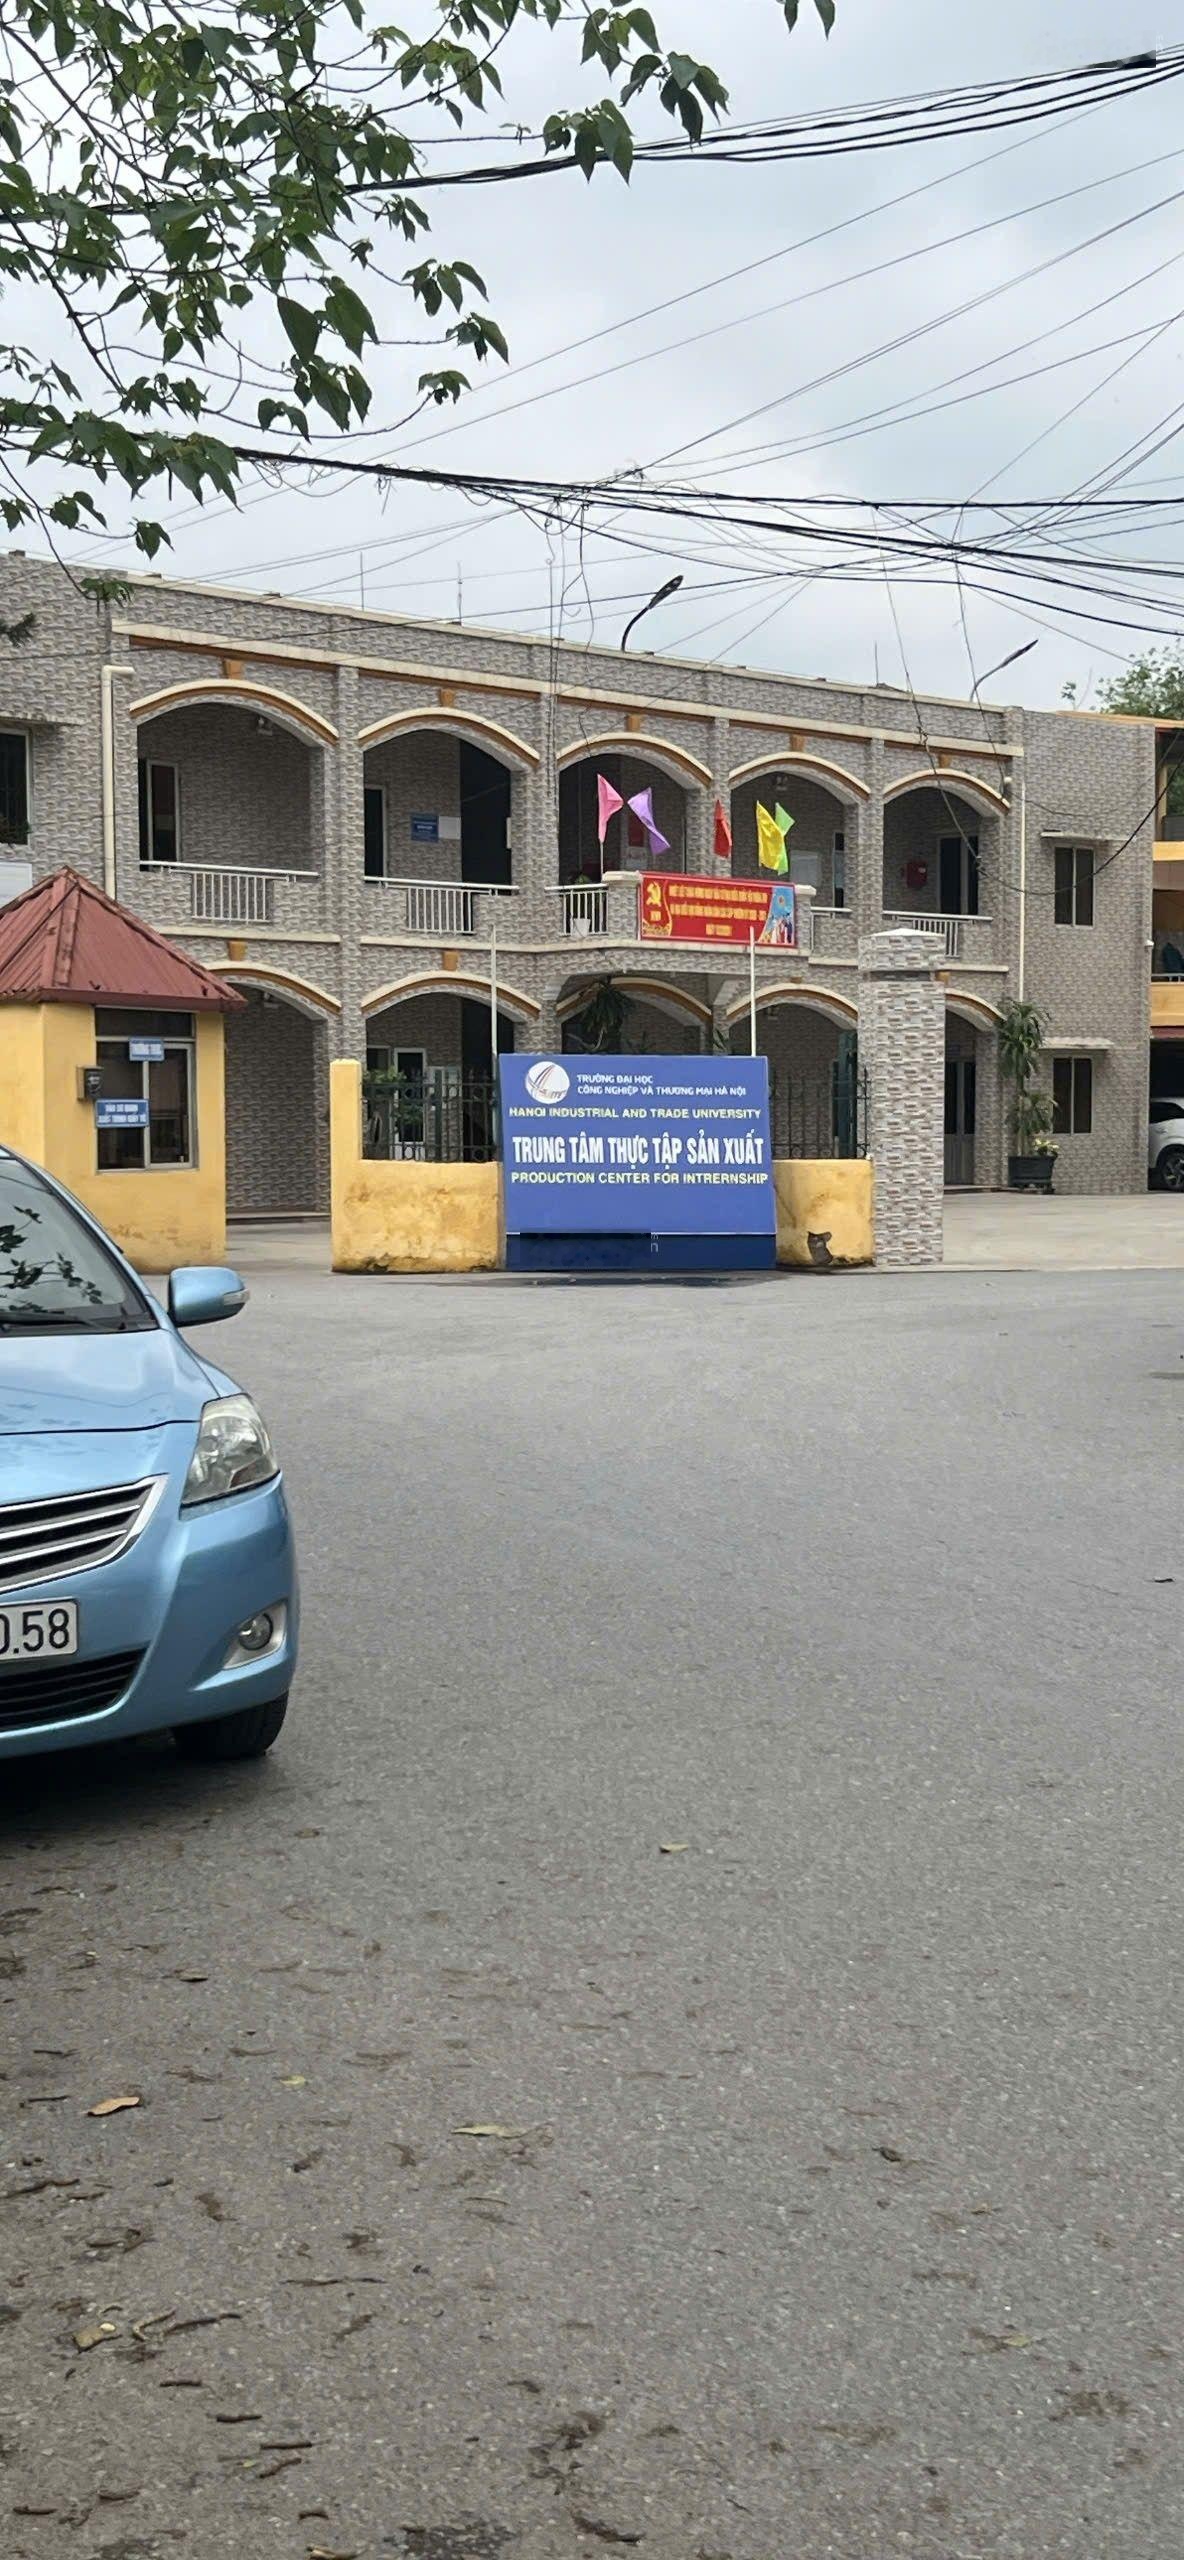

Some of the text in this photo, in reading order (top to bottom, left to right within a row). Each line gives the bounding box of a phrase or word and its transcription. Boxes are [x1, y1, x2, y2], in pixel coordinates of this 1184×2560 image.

[634, 1075, 653, 1087] HỌC
[577, 1084, 603, 1095] CÔNG
[604, 1086, 639, 1097] NGHIỆP
[639, 1086, 654, 1096] VÀ
[714, 1085, 729, 1096] HÀ
[730, 1085, 746, 1097] NỘI
[509, 1107, 761, 1119] HANOI INDUSTRIAL AND TRADE UNIVERSITY
[512, 1129, 764, 1170] TRUNG TÂM THỰC TẬP SẢN XUẤT
[511, 1172, 769, 1185] PRODUCTION CENTER FOR INTRERNSHIP
